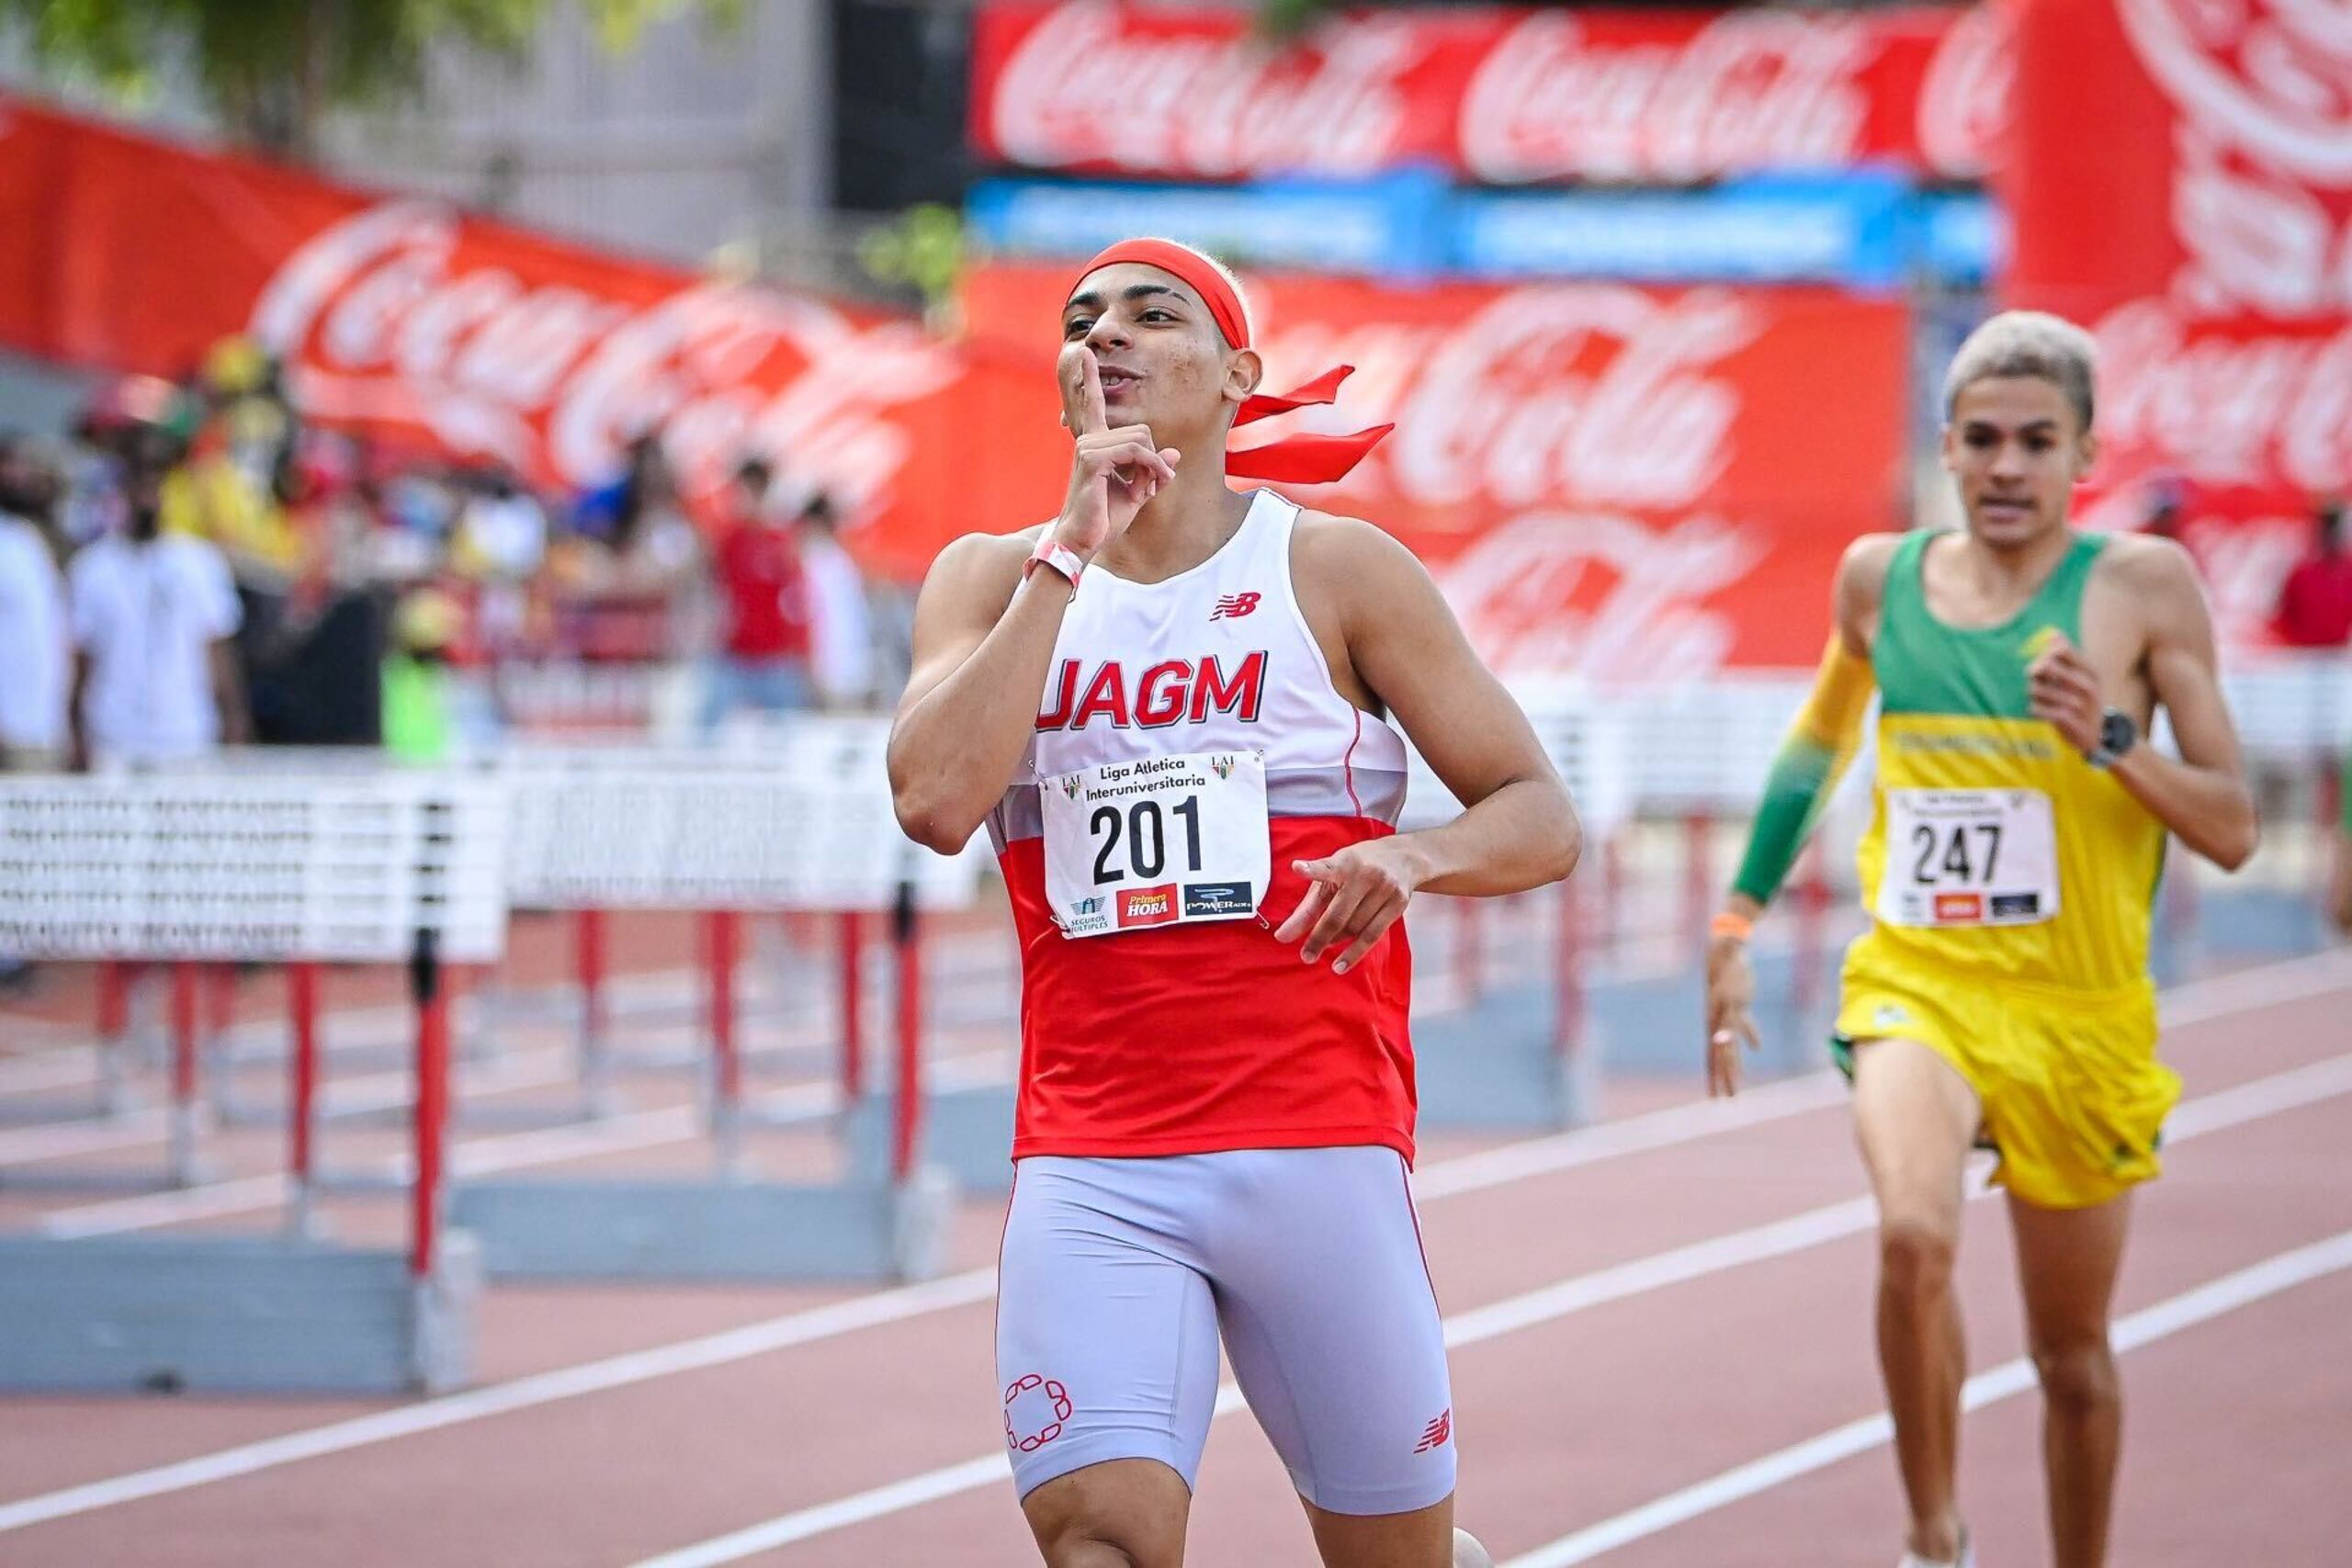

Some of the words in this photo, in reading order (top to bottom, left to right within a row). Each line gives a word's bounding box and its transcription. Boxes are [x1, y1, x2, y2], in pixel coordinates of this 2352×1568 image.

[1100, 767, 1131, 782] Liga
[1133, 757, 1186, 776] Atletica
[1086, 773, 1206, 802] Interuniversitaria
[1090, 795, 1202, 886] 201
[1911, 824, 2002, 886] 247
[1126, 901, 1169, 917] HORA
[1128, 894, 1168, 905] Primero
[1071, 915, 1106, 927] SEGUROS
